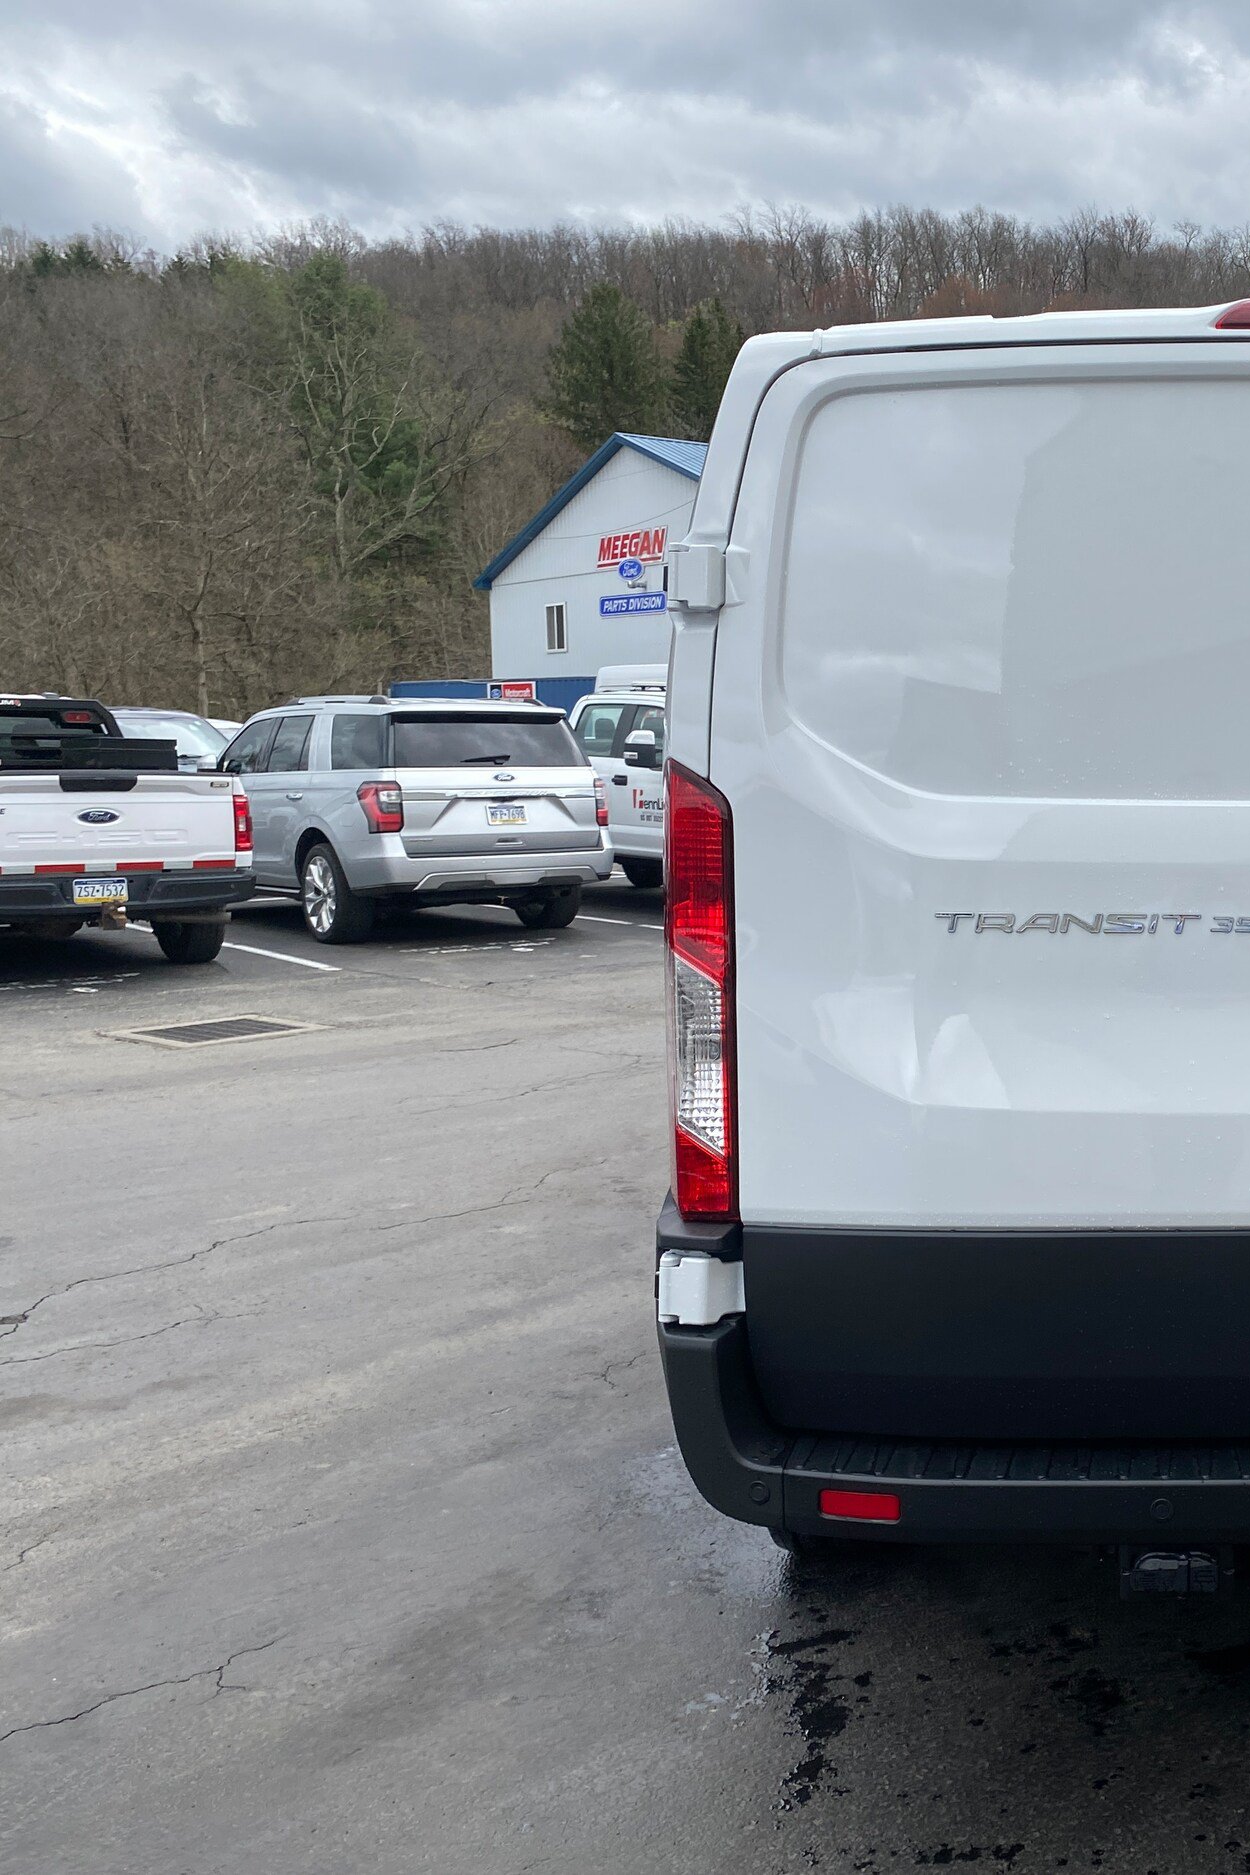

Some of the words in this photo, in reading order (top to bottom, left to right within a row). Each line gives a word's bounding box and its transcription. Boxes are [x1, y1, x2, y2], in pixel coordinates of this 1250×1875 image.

[598, 528, 665, 561] MEEGAN
[603, 599, 627, 612] PARTS
[628, 596, 663, 611] DIVISION
[87, 811, 111, 822] Ford
[6, 828, 188, 848] F-150
[935, 912, 1201, 934] TRANSIT
